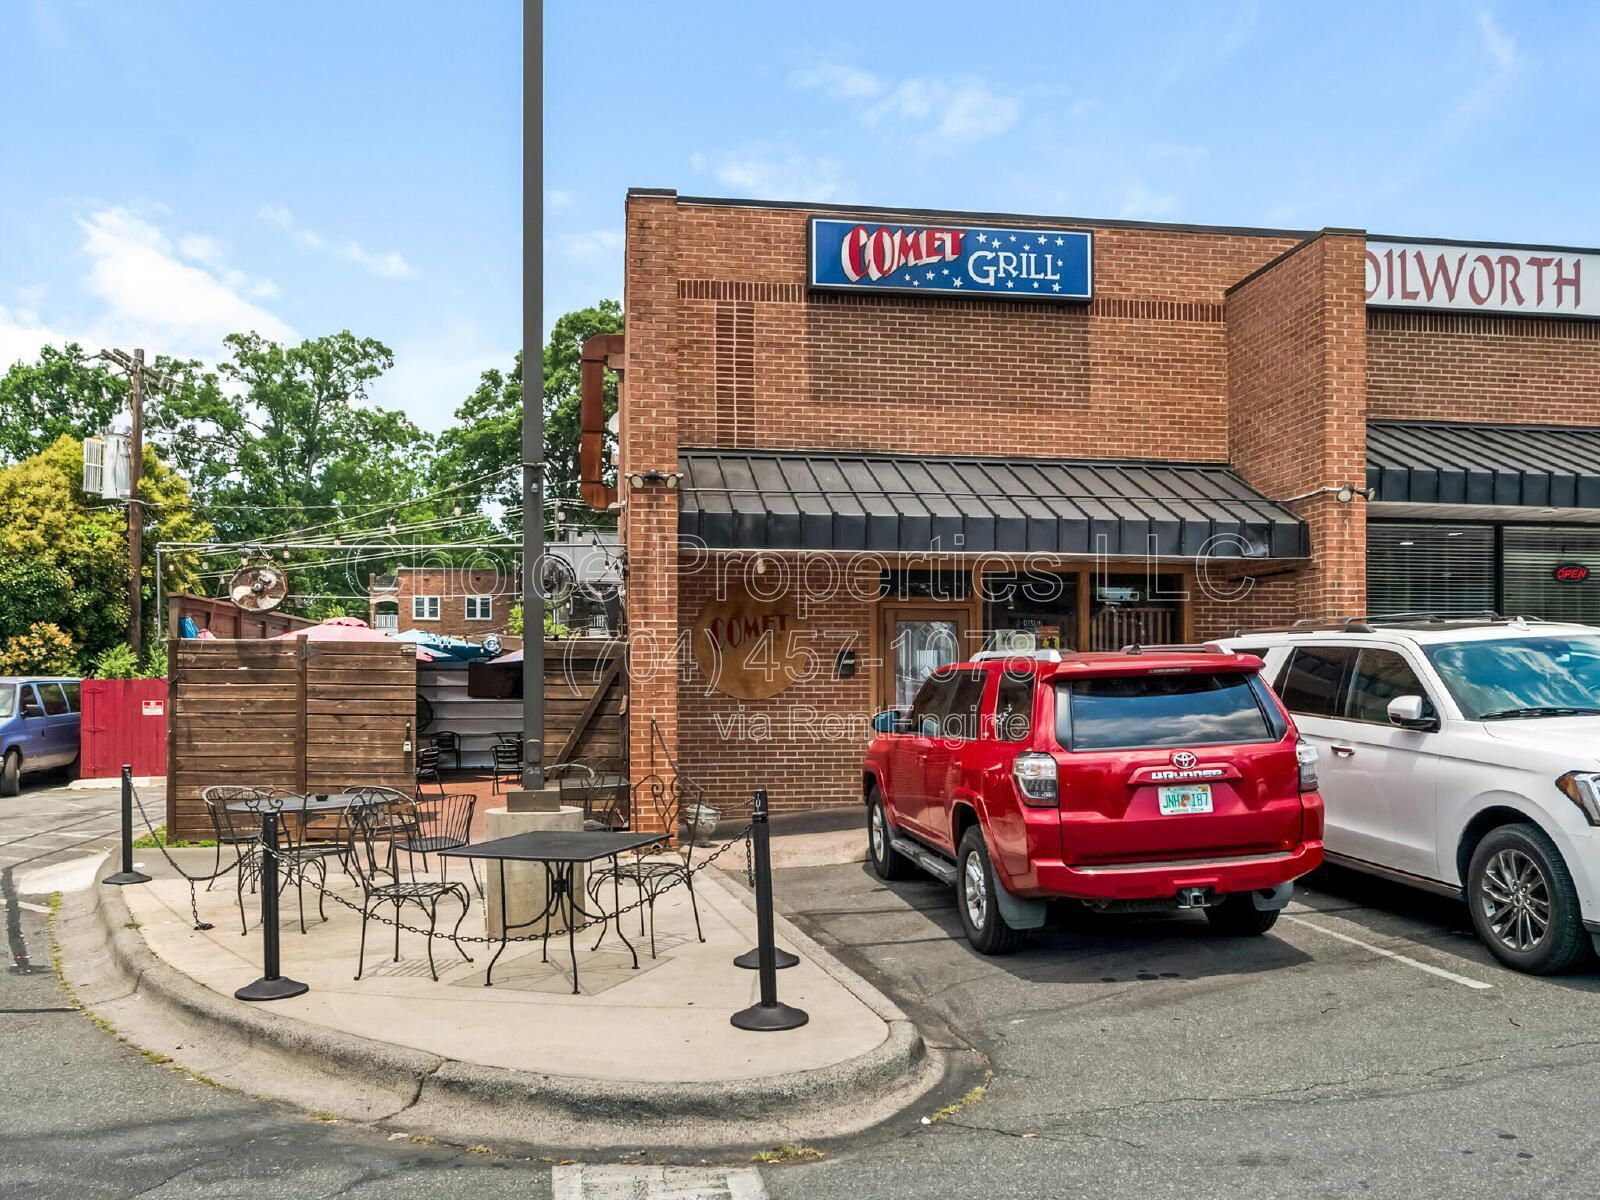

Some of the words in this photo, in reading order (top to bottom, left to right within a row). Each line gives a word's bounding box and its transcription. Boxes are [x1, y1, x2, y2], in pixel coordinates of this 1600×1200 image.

[841, 225, 965, 283] COMET
[967, 250, 1061, 287] GRILL
[1557, 569, 1587, 579] OPEN
[707, 613, 790, 652] COMET
